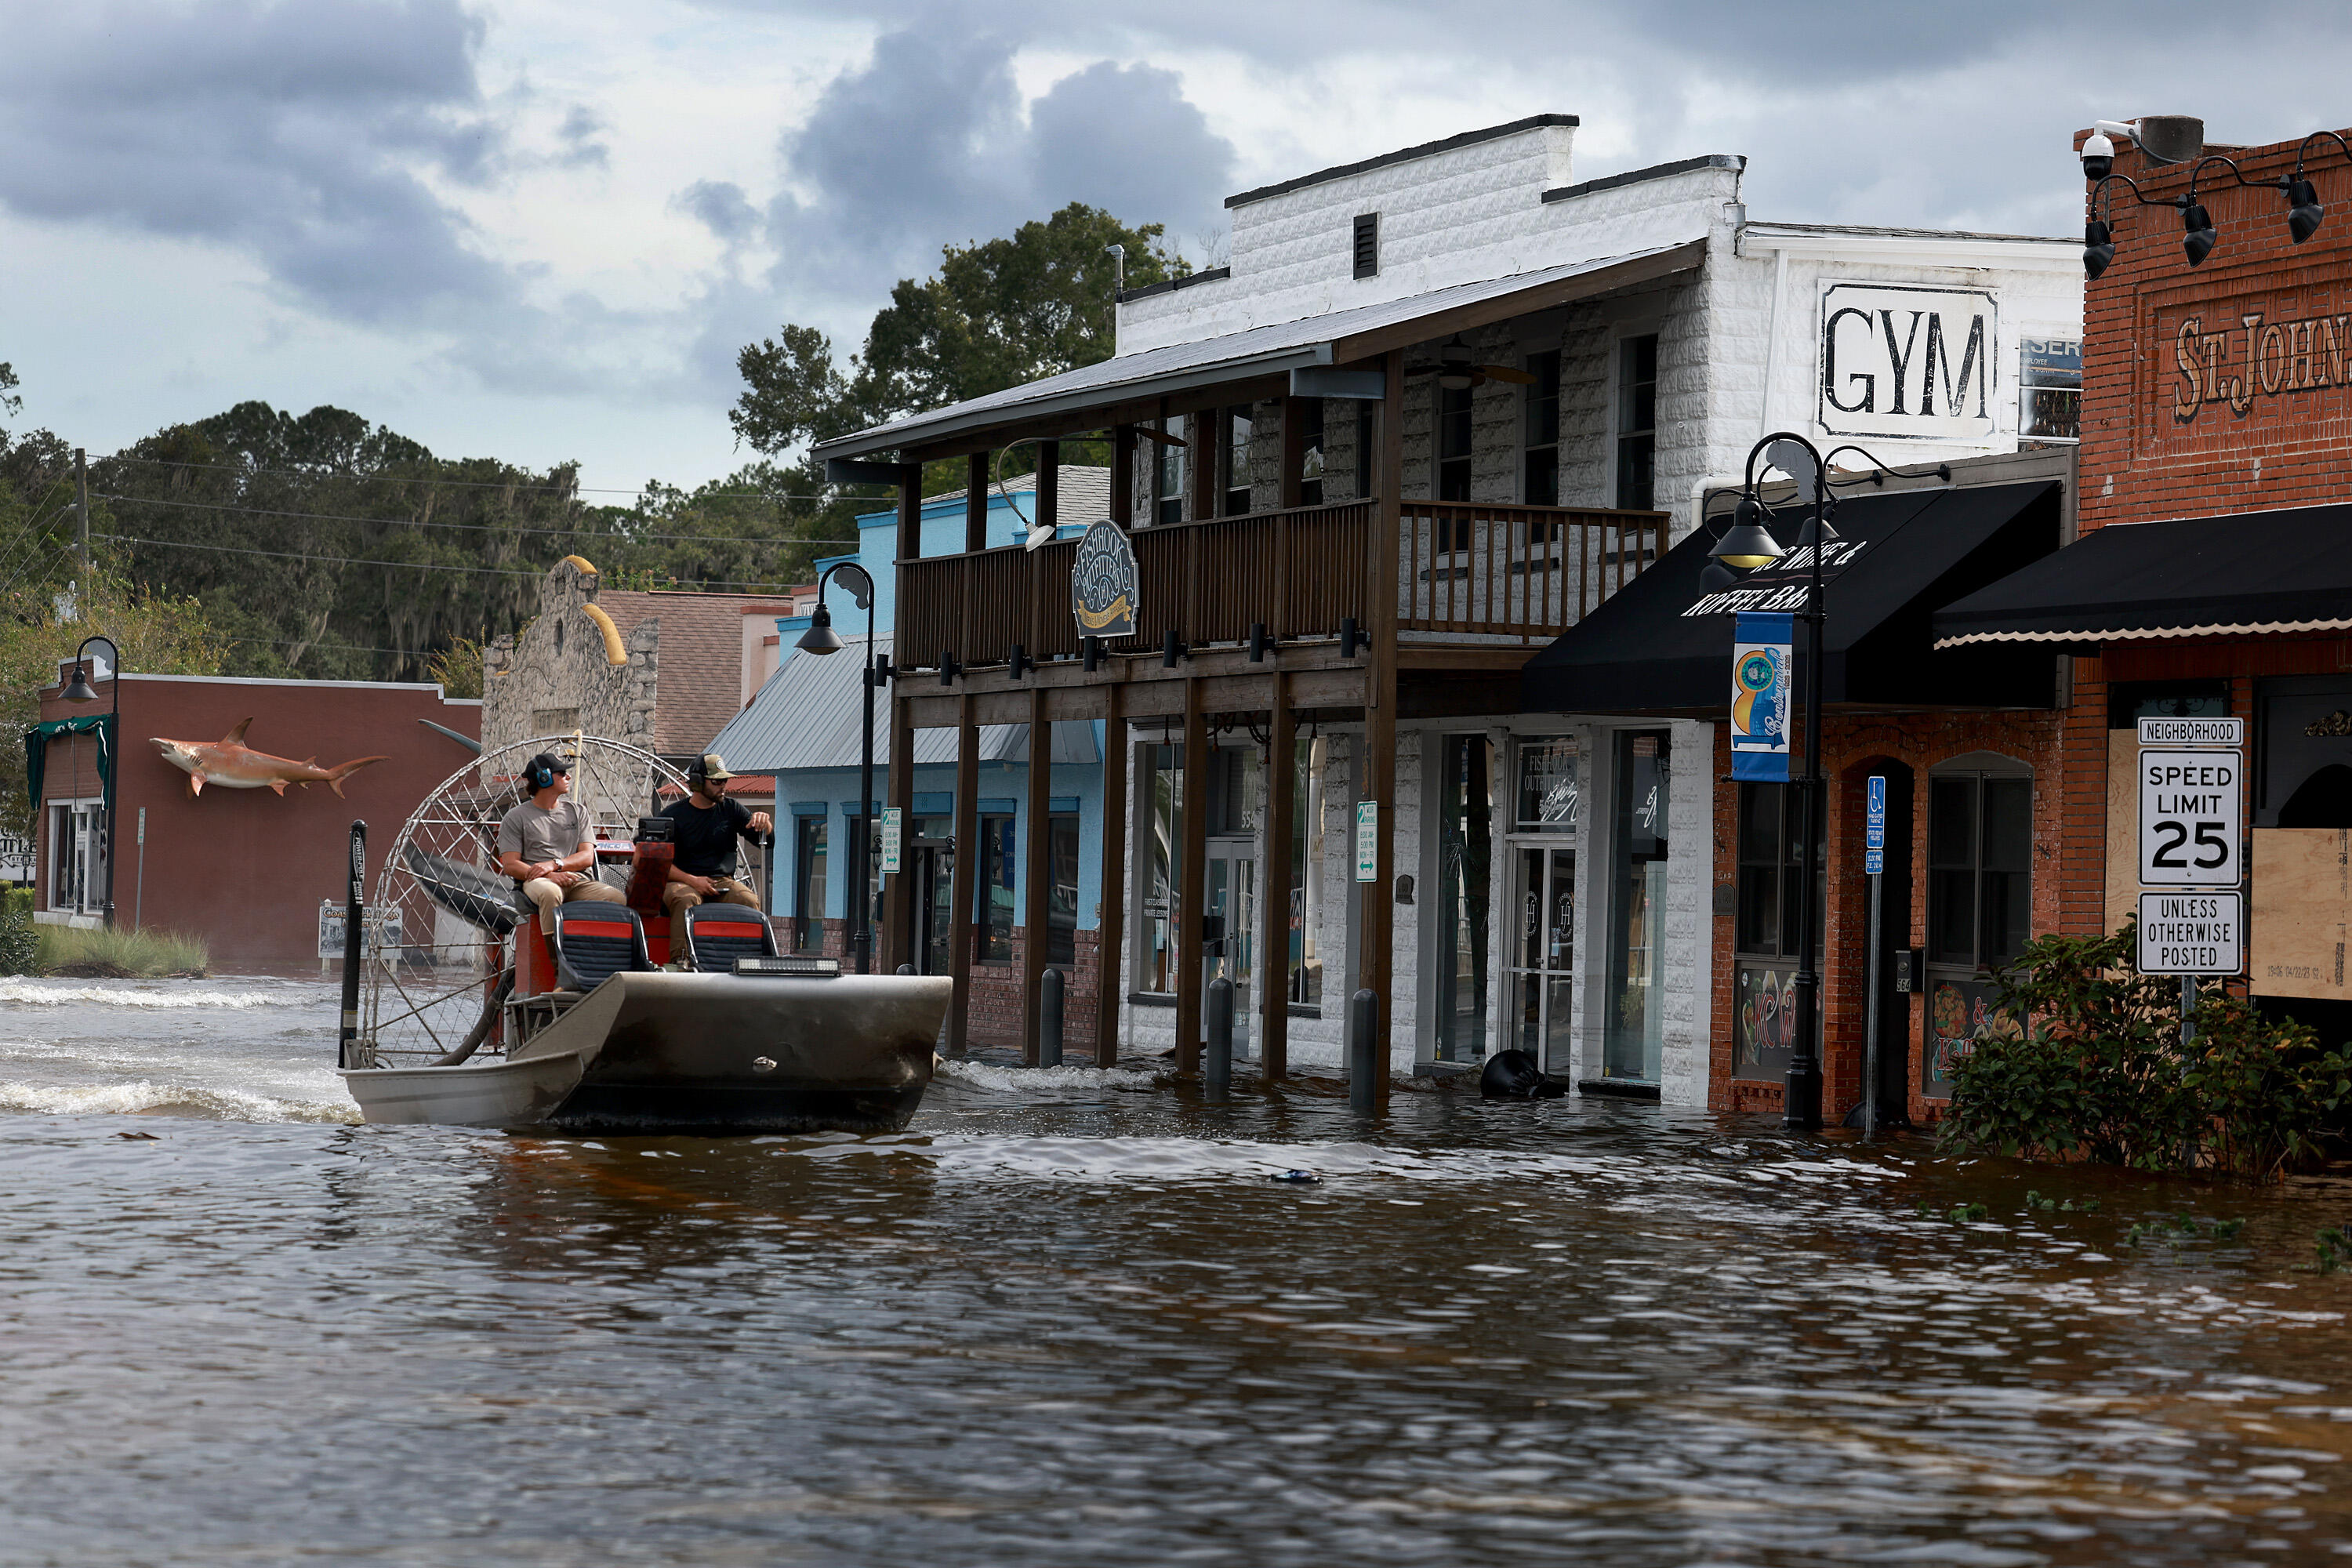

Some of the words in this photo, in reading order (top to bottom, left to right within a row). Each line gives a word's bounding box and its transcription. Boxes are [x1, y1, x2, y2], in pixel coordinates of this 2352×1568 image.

[1824, 307, 1991, 419] GYM
[2230, 314, 2352, 418] JOHN
[1681, 589, 1776, 617] KOFFEE
[1764, 649, 1784, 736] Centennial
[2147, 723, 2234, 740] NEIGHBORHOOD
[1530, 755, 1568, 771] FISHHOOK
[2149, 767, 2232, 786] SPEED
[2158, 794, 2222, 814] LIMIT
[2152, 821, 2229, 869] 25
[2161, 899, 2217, 919] UNLESS
[2148, 923, 2230, 942] OTHERWISE
[2161, 947, 2217, 967] POSTED
[1897, 979, 1911, 991] 564
[1973, 996, 1988, 1025] &
